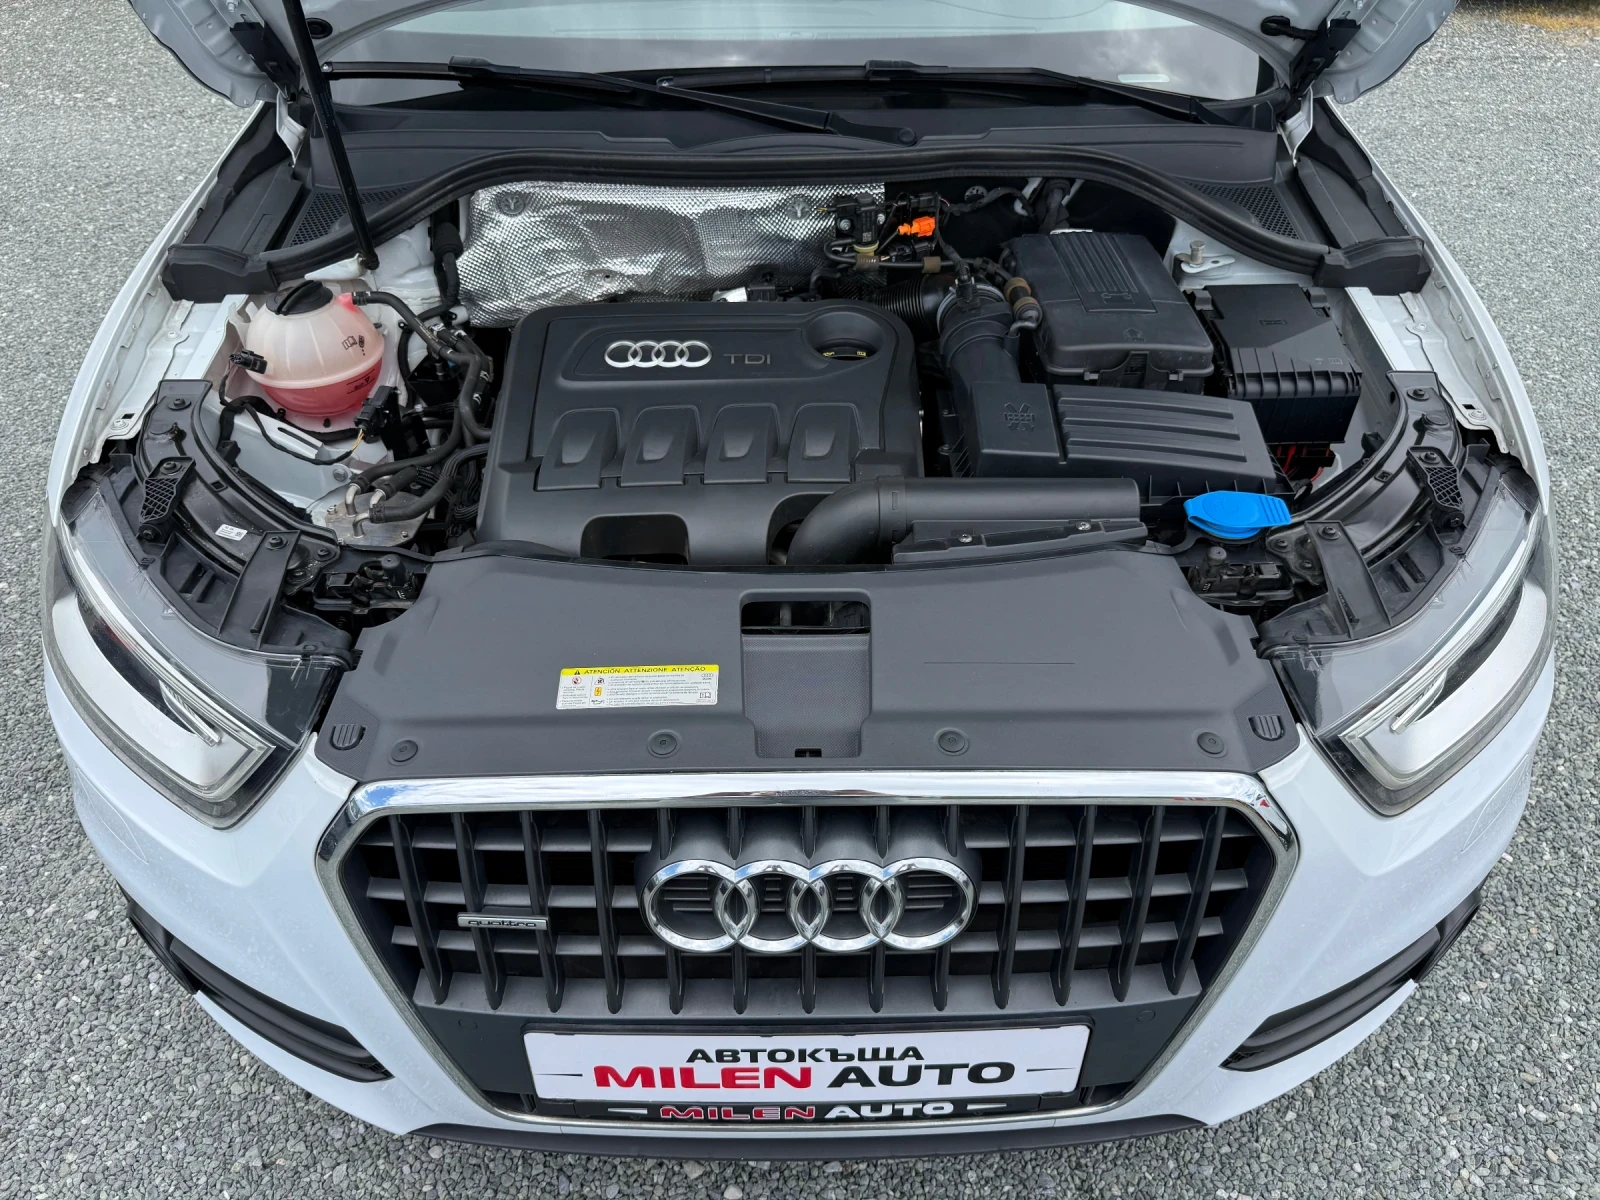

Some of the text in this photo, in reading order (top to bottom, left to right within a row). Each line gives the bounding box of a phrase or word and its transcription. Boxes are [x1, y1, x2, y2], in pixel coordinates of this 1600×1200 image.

[723, 354, 771, 365] TDI
[468, 920, 537, 928] quattro
[686, 1046, 925, 1064] АВТОКЪША
[593, 1061, 1016, 1089] MILEN AUTO
[659, 1102, 954, 1120] MILEN AUTO
